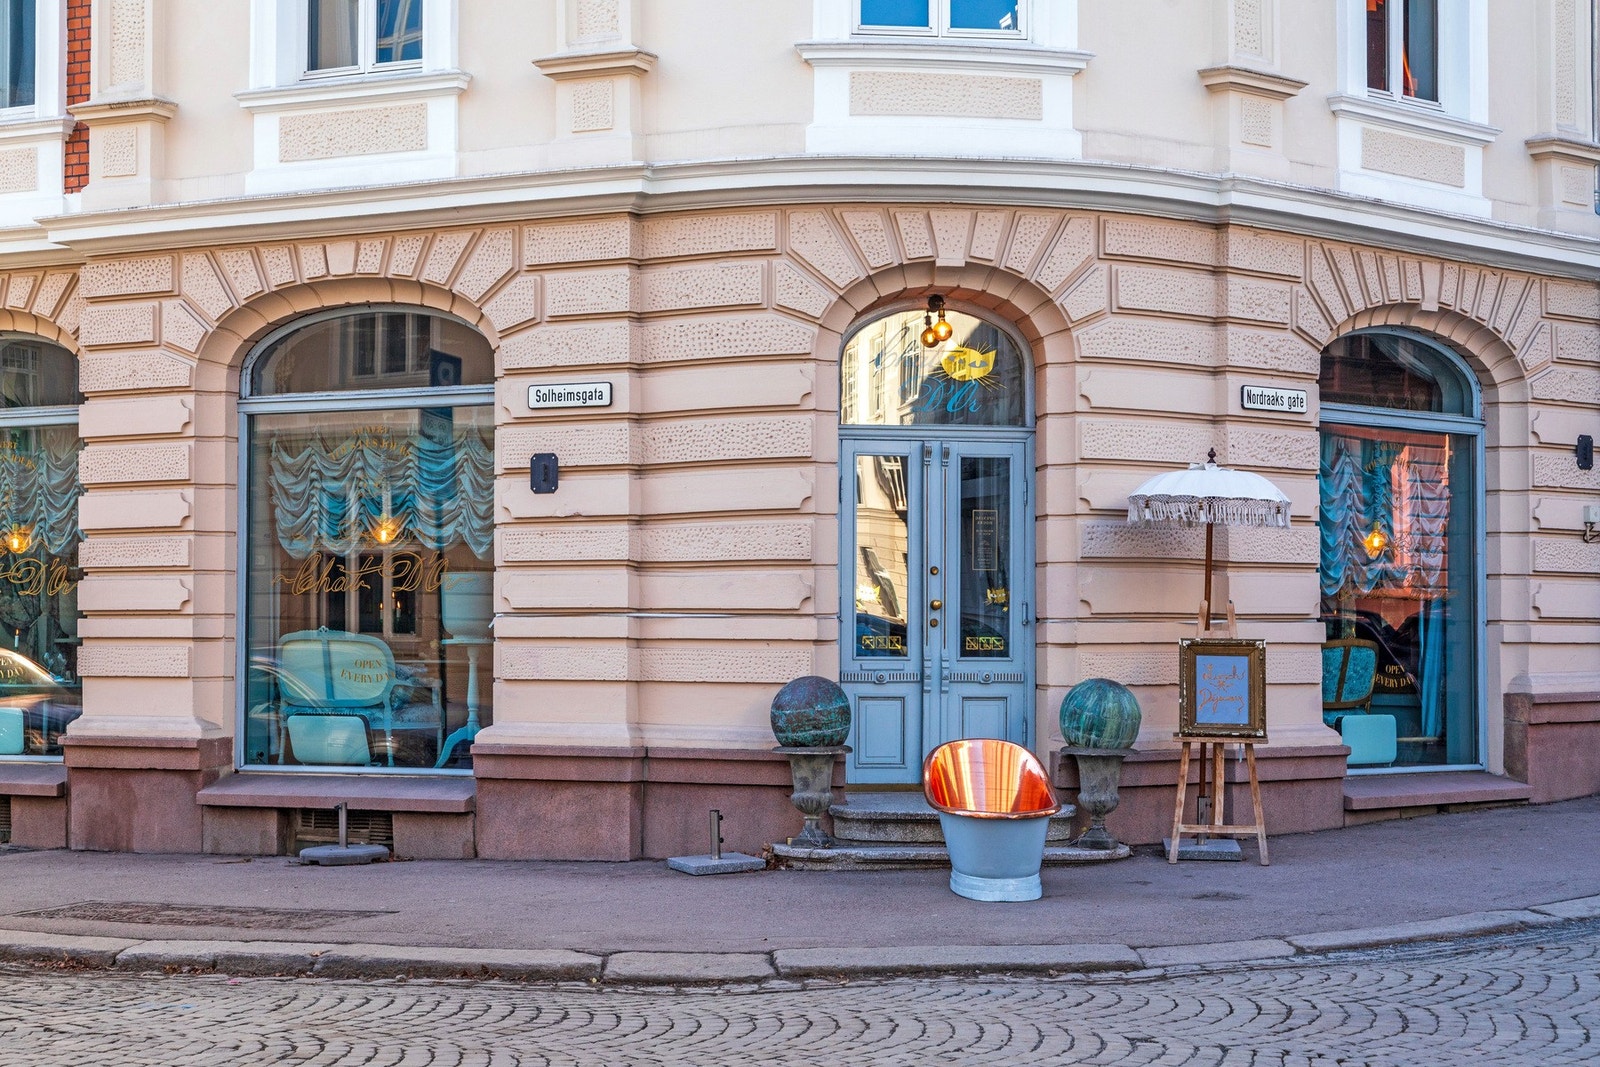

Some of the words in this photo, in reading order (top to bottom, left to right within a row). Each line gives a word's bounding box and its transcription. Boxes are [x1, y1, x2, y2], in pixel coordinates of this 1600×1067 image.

[535, 387, 603, 404] Solheimsgata
[1246, 389, 1284, 406] Nordraaks
[1287, 393, 1304, 410] gate
[8, 557, 78, 596] D'Or
[354, 658, 383, 669] OPEN
[1385, 664, 1406, 674] OPEN
[341, 668, 373, 684] EVERY
[1375, 673, 1399, 688] EVERY
